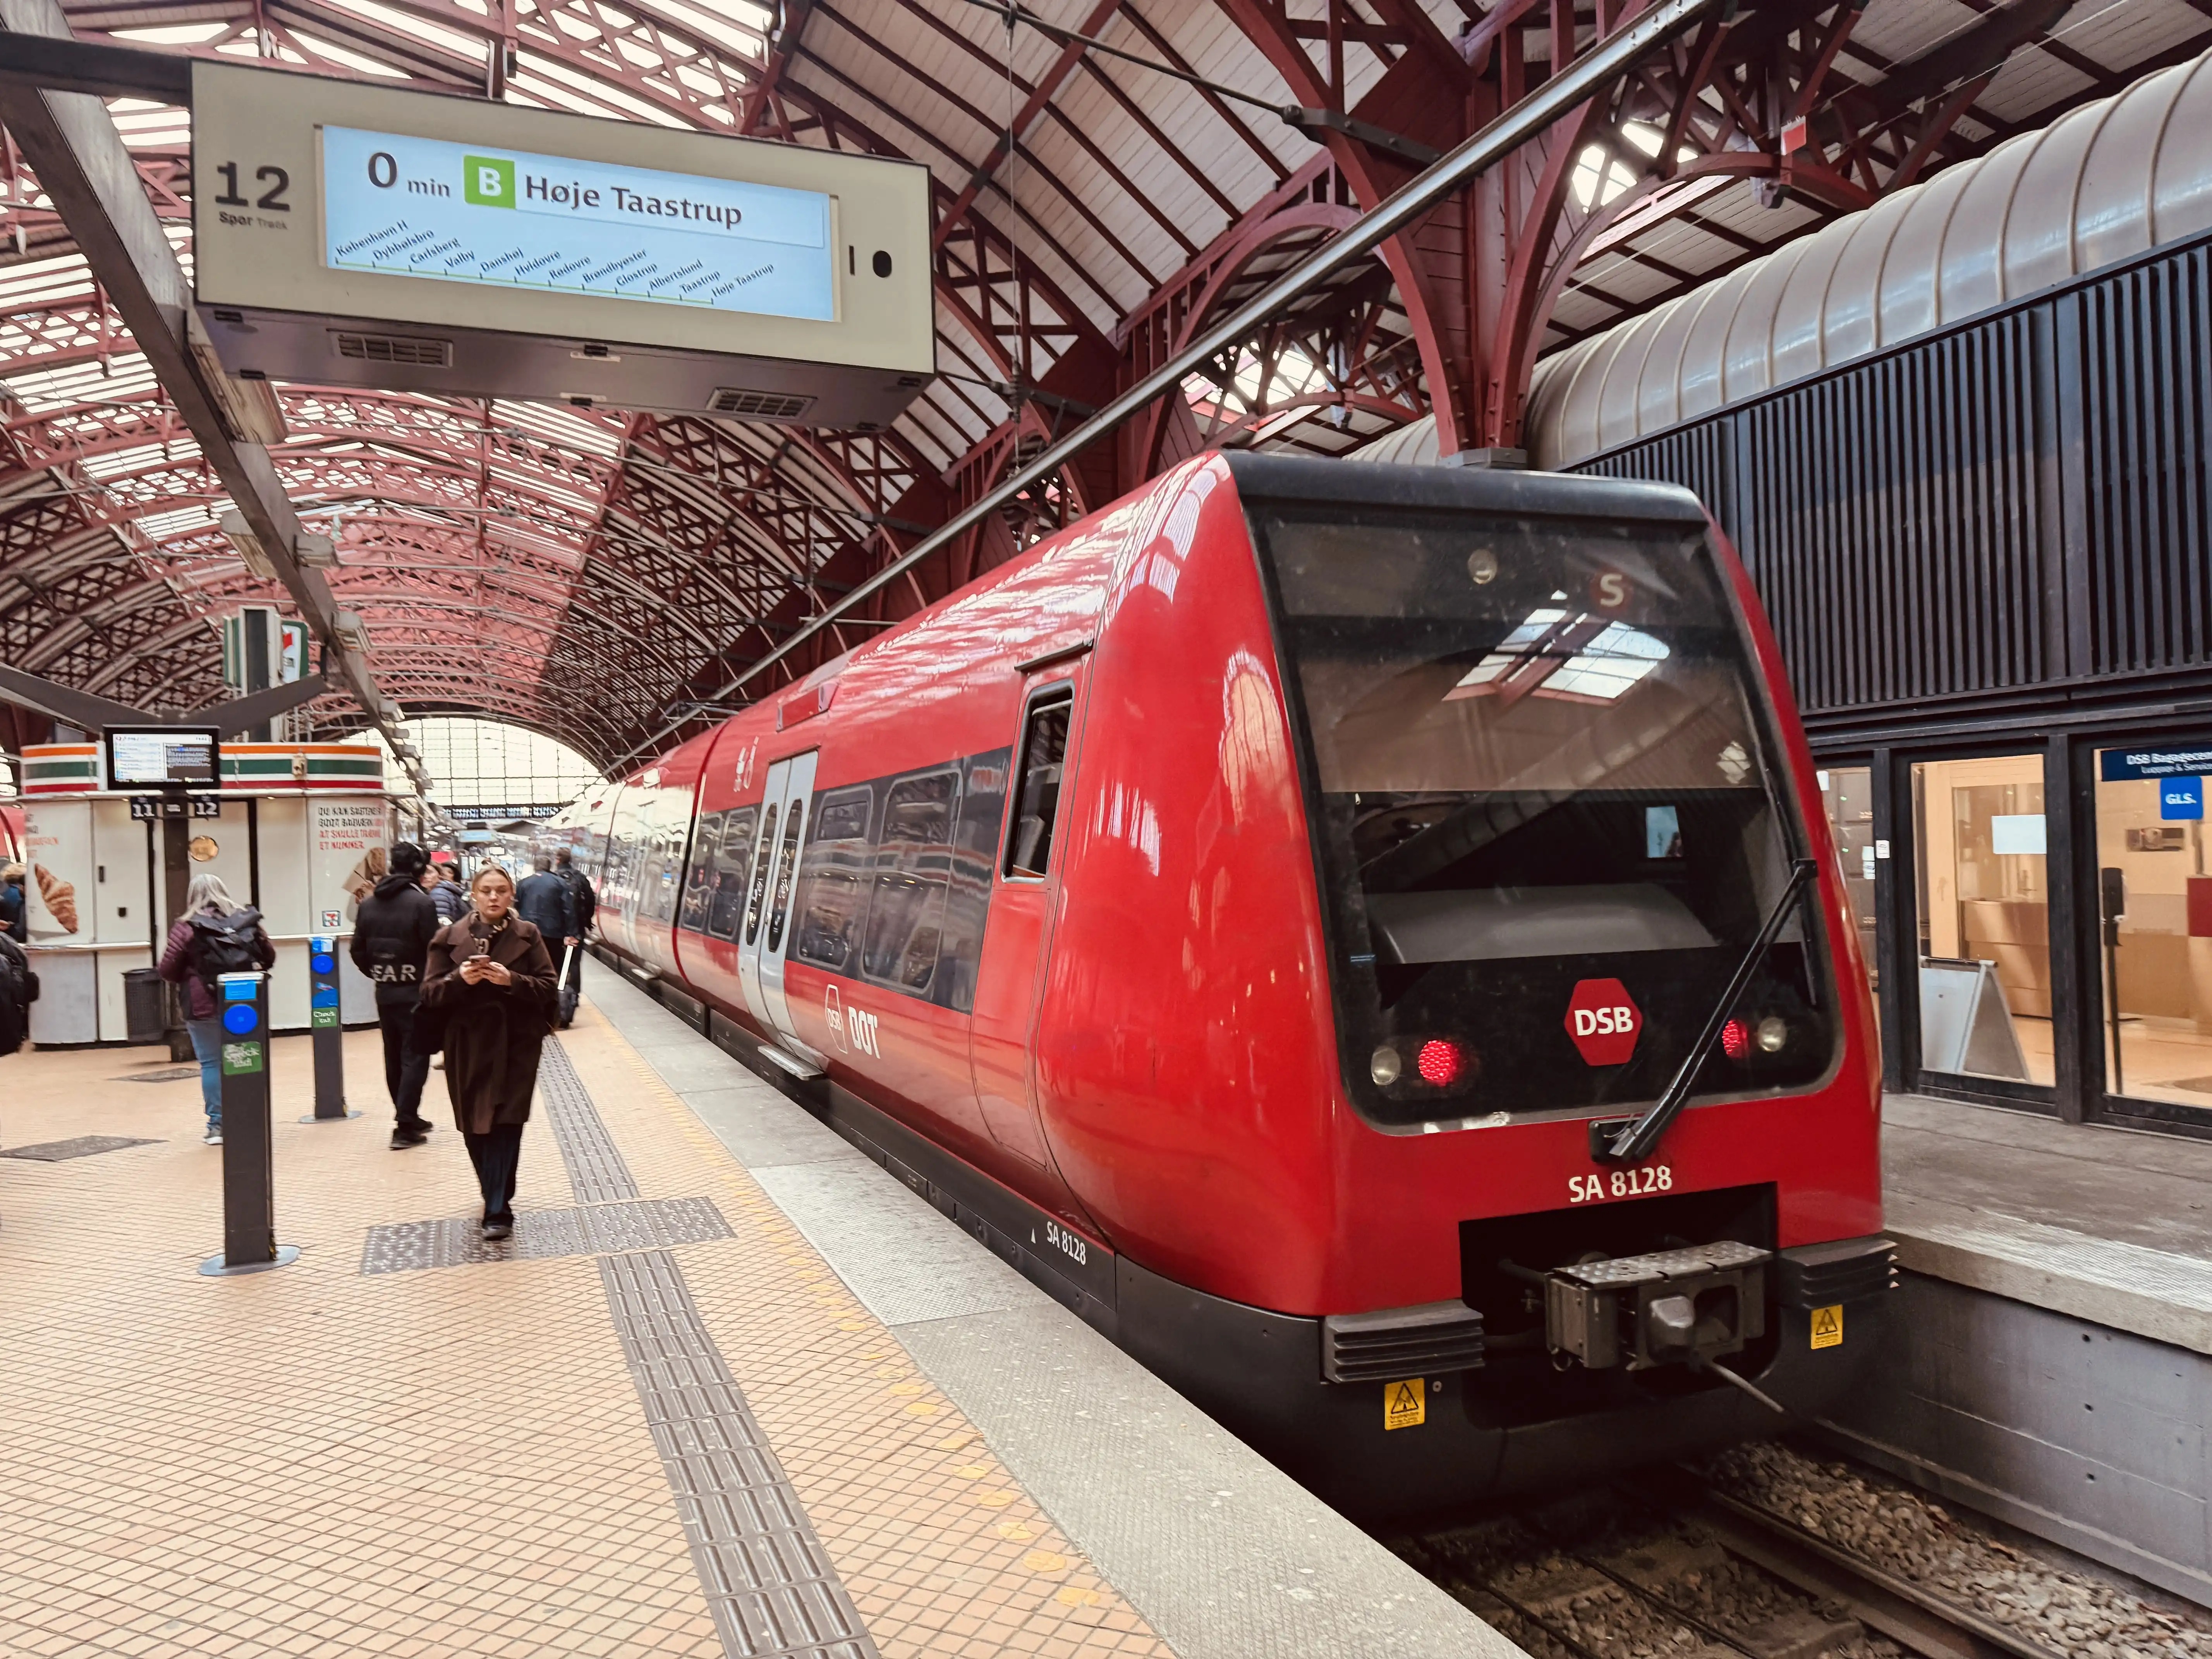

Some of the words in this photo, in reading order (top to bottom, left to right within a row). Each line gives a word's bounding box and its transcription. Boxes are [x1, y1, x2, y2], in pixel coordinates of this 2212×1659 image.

[215, 161, 290, 211] 12
[368, 152, 397, 188] 0
[407, 178, 450, 198] min
[479, 167, 502, 196] B
[526, 175, 600, 210] Høje
[611, 186, 741, 230] Taastrup
[219, 211, 253, 226] Spor
[397, 220, 409, 232] H
[410, 237, 461, 264] Carlsberg
[445, 250, 475, 268] Valby
[514, 250, 561, 276] Hvidovre
[616, 262, 658, 286] Glostrup
[649, 258, 703, 291] Albertslund
[679, 270, 720, 294] Taastrup
[735, 263, 774, 287] Taastrup
[1600, 574, 1624, 607] S
[133, 804, 155, 817] 11
[196, 802, 217, 815] 12
[848, 1006, 881, 1059] DOT
[1574, 1006, 1633, 1036] DSB
[1569, 1174, 1604, 1203] SA
[1611, 1164, 1672, 1197] 8128
[1047, 1221, 1060, 1248] SA
[1062, 1231, 1086, 1265] 8128
